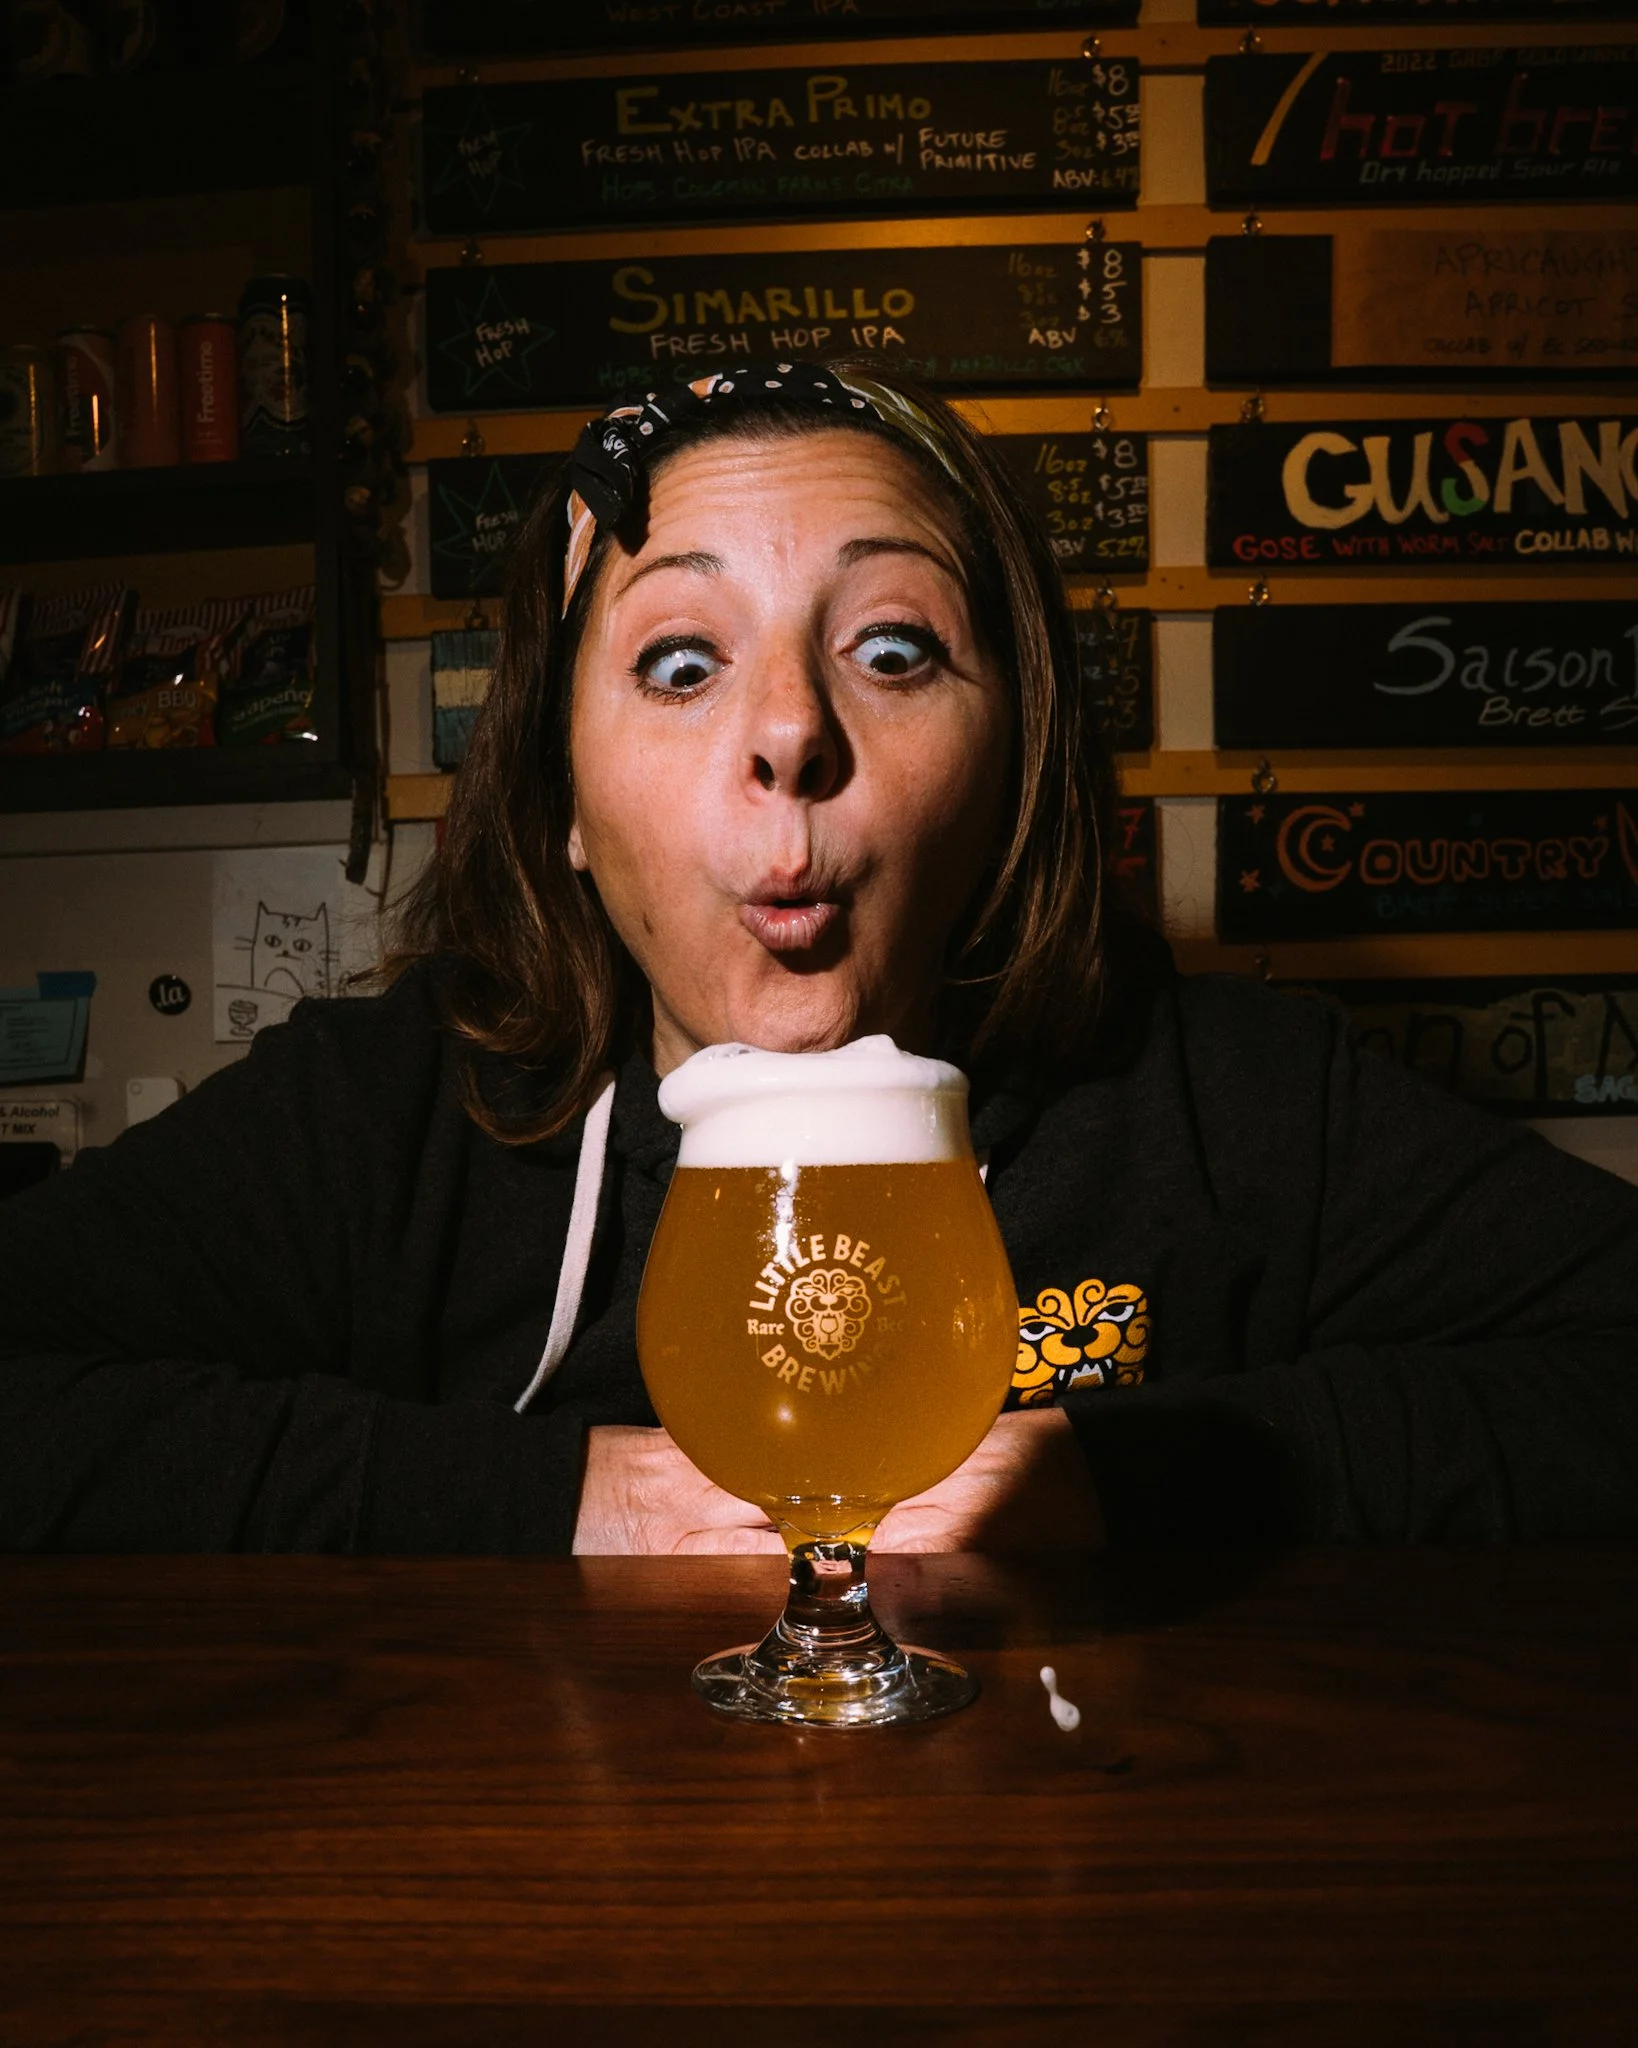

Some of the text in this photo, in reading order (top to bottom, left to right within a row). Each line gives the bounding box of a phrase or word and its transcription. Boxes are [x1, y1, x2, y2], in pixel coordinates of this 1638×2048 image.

[604, 3, 683, 24] WEST
[691, 0, 788, 21] COAST
[917, 126, 1009, 150] FUTURE
[580, 138, 663, 168] FRESH
[733, 136, 778, 162] IPA
[918, 149, 1038, 173] PRIMITIVE
[474, 316, 531, 343] FRESH
[648, 324, 906, 361] FRESH HOP IPA
[1027, 325, 1078, 350] ABV
[1033, 441, 1089, 475] 16oz
[1231, 533, 1322, 562] GOSE
[1399, 531, 1461, 556] WORM
[1513, 526, 1613, 555] COLLAB
[1372, 615, 1619, 696] Saison
[157, 689, 198, 709] BBQ
[1476, 695, 1588, 729] Brett
[10, 1105, 60, 1119] Alcohol
[12, 1123, 37, 1136] MIX
[832, 1233, 909, 1308] BEAST
[745, 1317, 786, 1337] Rare
